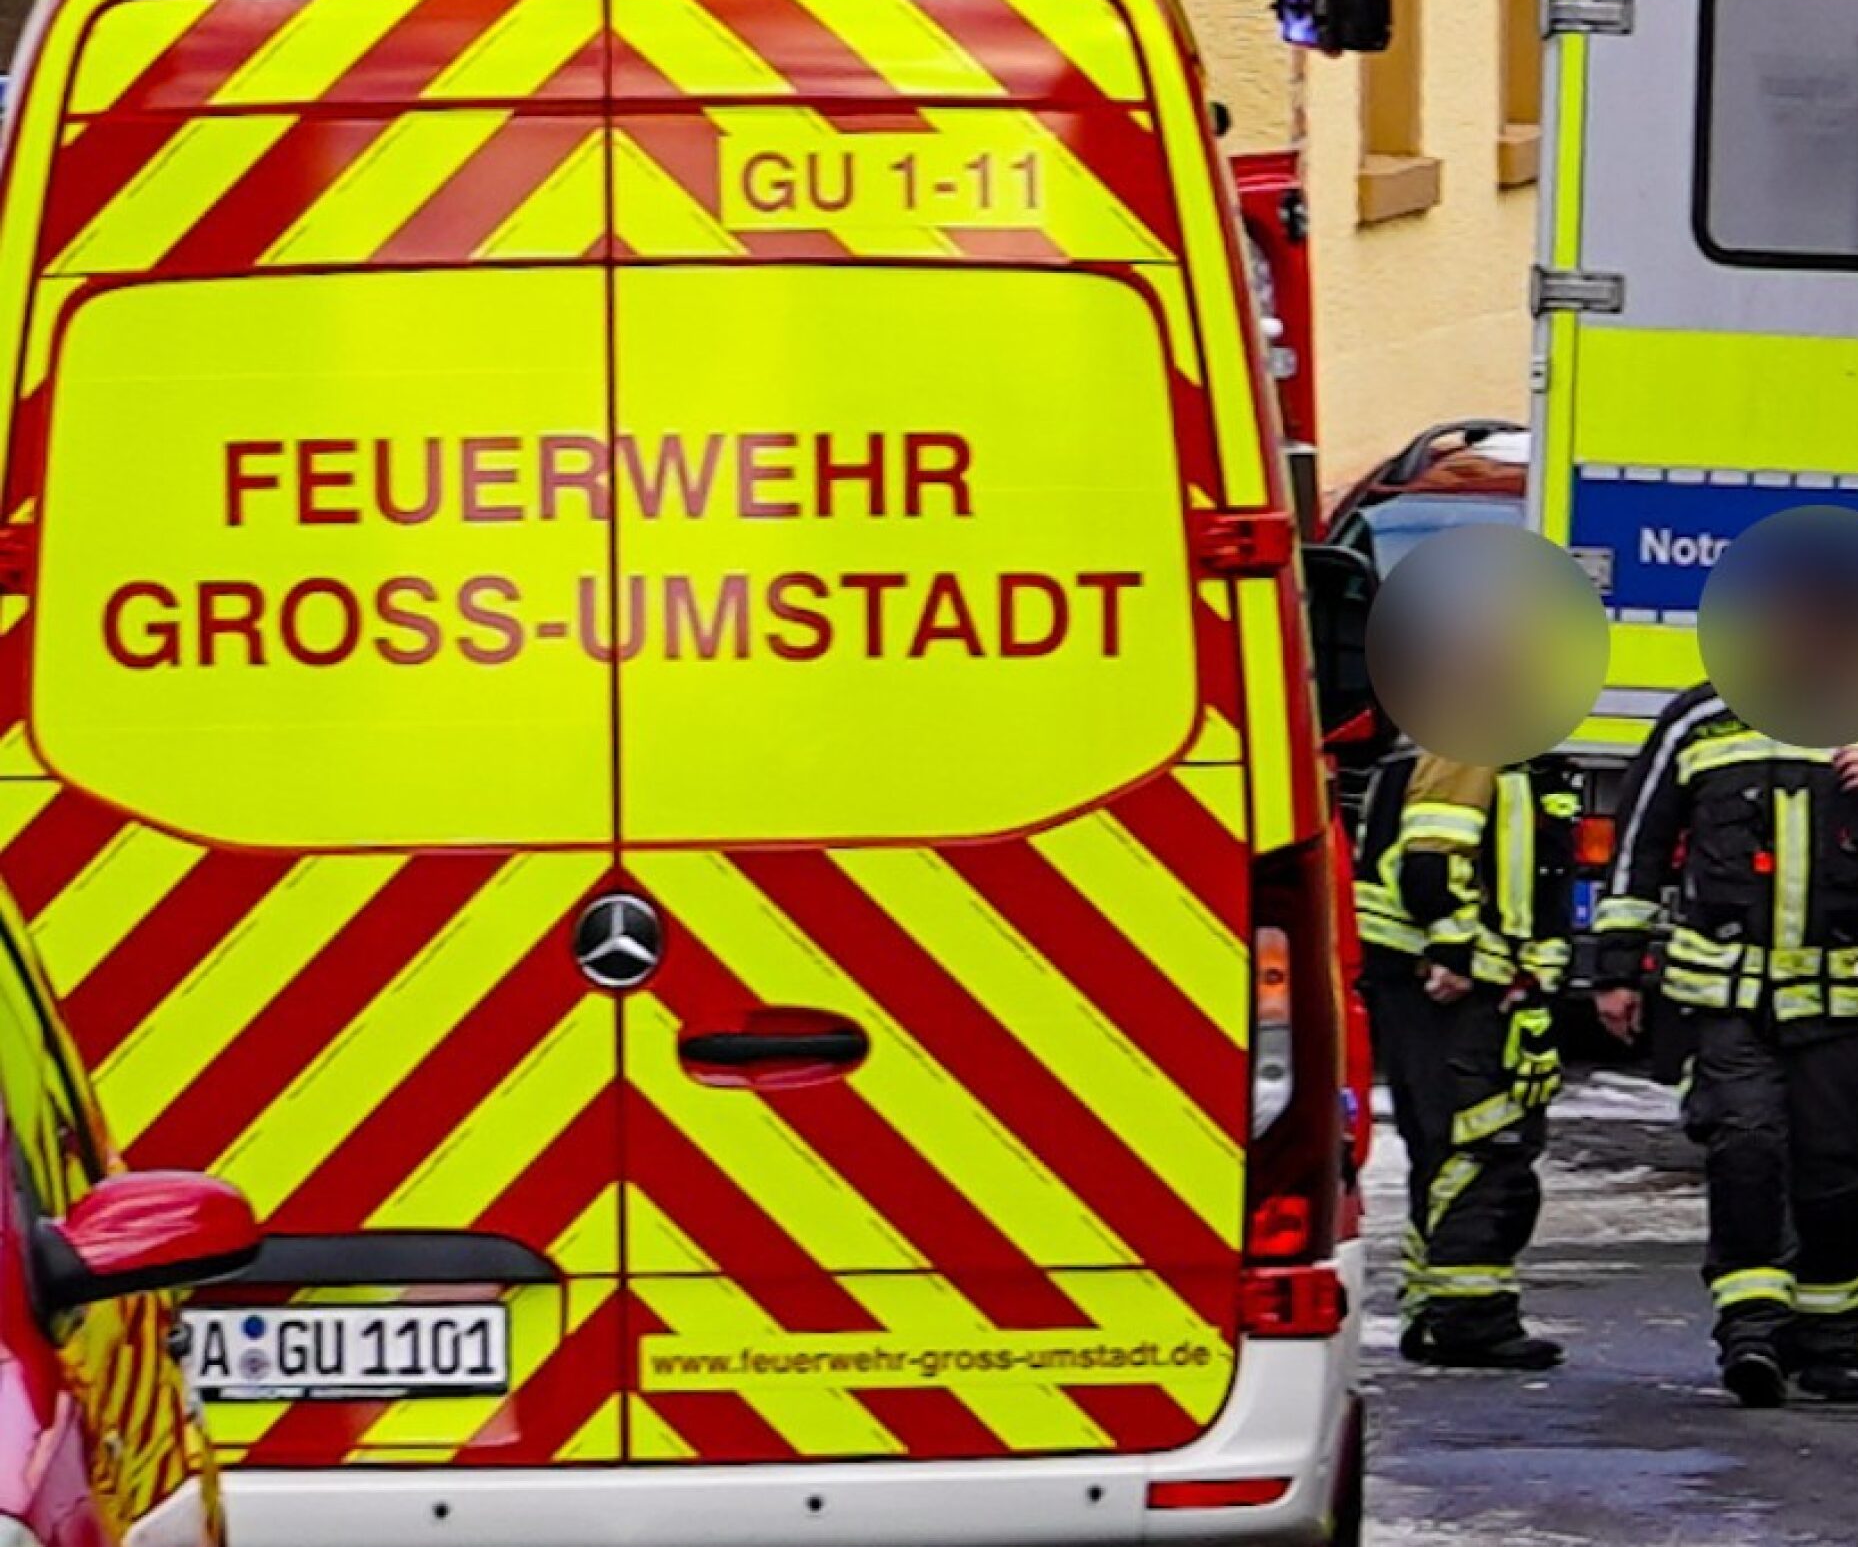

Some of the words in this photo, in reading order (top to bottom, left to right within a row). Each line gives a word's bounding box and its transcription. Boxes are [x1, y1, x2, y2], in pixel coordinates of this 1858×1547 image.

[741, 151, 855, 212] GU
[889, 152, 1040, 209] 1-11
[224, 431, 975, 528] FEUERWEHR
[102, 569, 1143, 668] GROSS-UMSTADT
[277, 1319, 345, 1377] GU
[361, 1318, 496, 1376] 1101
[650, 1341, 1211, 1378] www.feuerwehr-gross-umstadt.de
